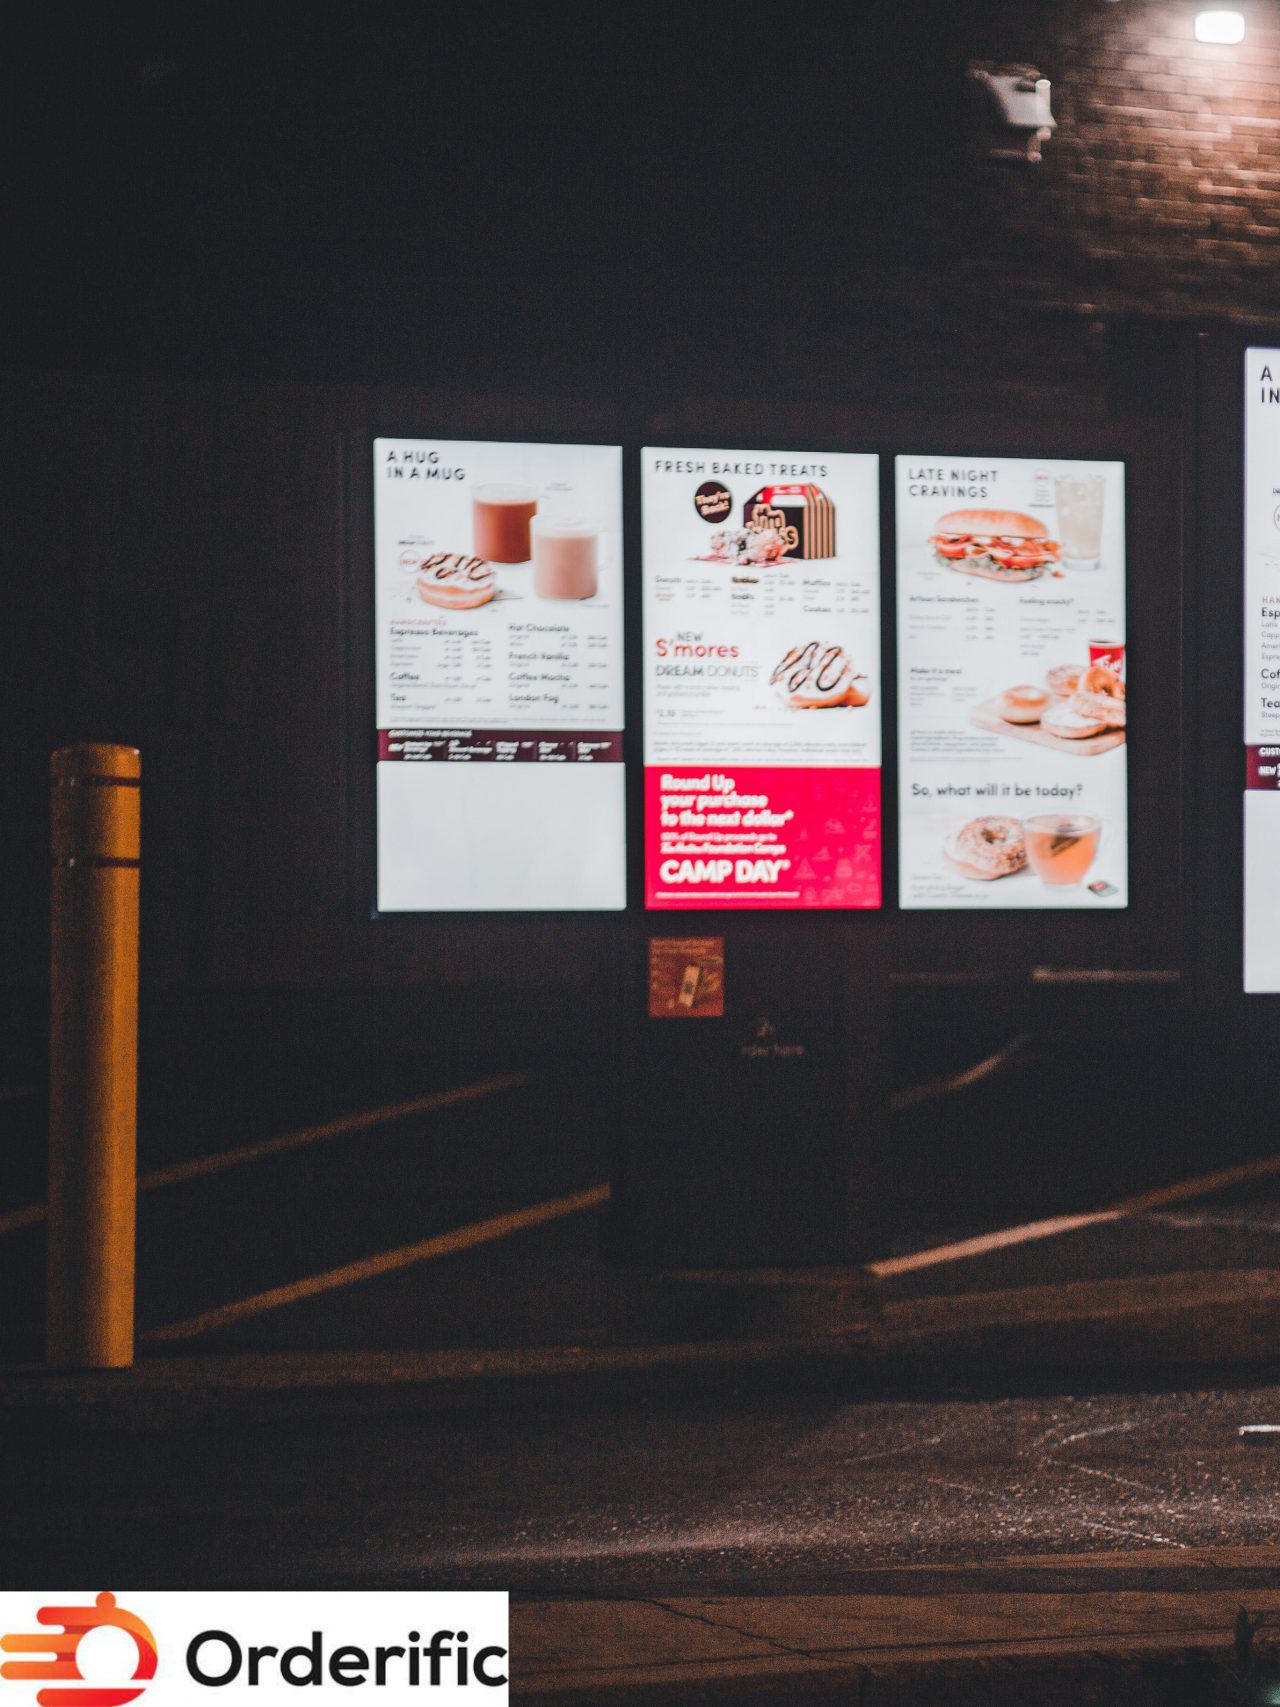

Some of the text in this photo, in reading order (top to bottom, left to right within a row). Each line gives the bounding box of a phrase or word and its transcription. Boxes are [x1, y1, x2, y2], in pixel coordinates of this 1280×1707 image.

[1260, 365, 1273, 382] A
[1260, 387, 1280, 404] IN
[387, 451, 440, 464] A HUG
[409, 467, 420, 479] A
[425, 467, 466, 480] MUG
[655, 460, 829, 477] FRESH BAKED TREATS
[909, 468, 999, 482] LATE NIGHT
[909, 485, 988, 498] CRAVINGS
[677, 631, 703, 642] NEW
[656, 638, 740, 657] S'mores
[656, 665, 704, 677] DREAM
[1261, 698, 1280, 708] Tea
[1259, 765, 1277, 776] NEW
[660, 774, 736, 793] Round Up
[912, 783, 1083, 800] So, what will it be today?
[660, 791, 768, 812] your purchase
[660, 811, 678, 827] to
[680, 810, 705, 827] the
[706, 811, 741, 827] next
[659, 859, 733, 884] CAMP
